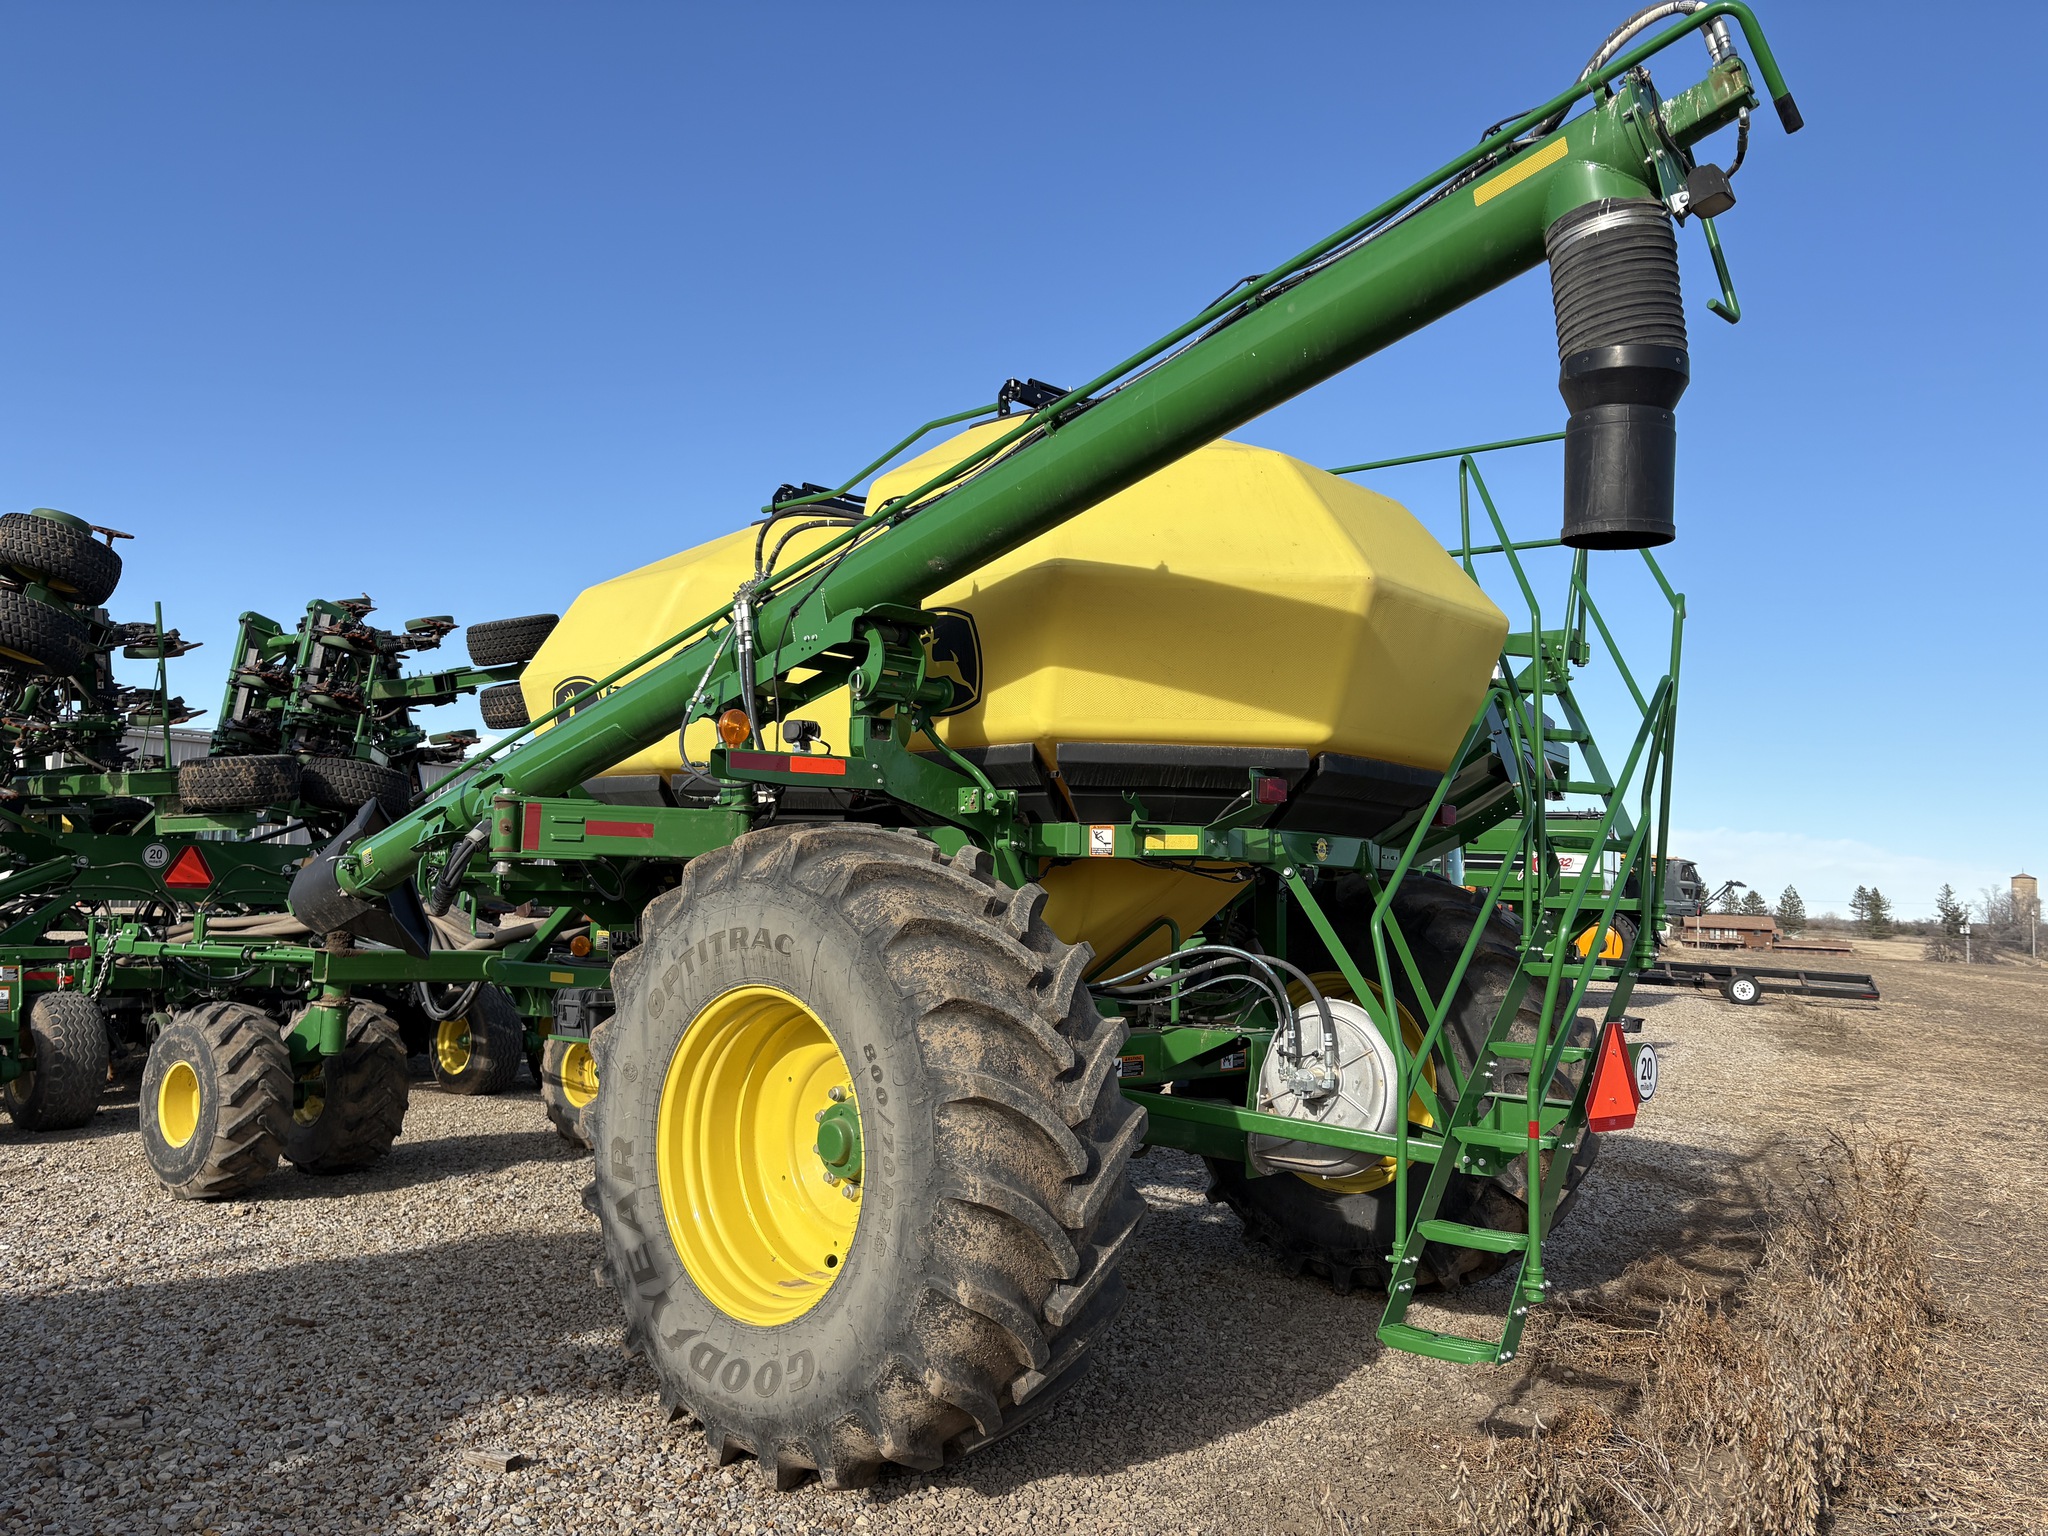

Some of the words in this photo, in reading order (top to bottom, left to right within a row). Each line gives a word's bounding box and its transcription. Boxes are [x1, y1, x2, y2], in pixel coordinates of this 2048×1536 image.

[149, 848, 163, 860] 20
[648, 926, 795, 1020] OPTITRAC
[1641, 1057, 1653, 1081] 20
